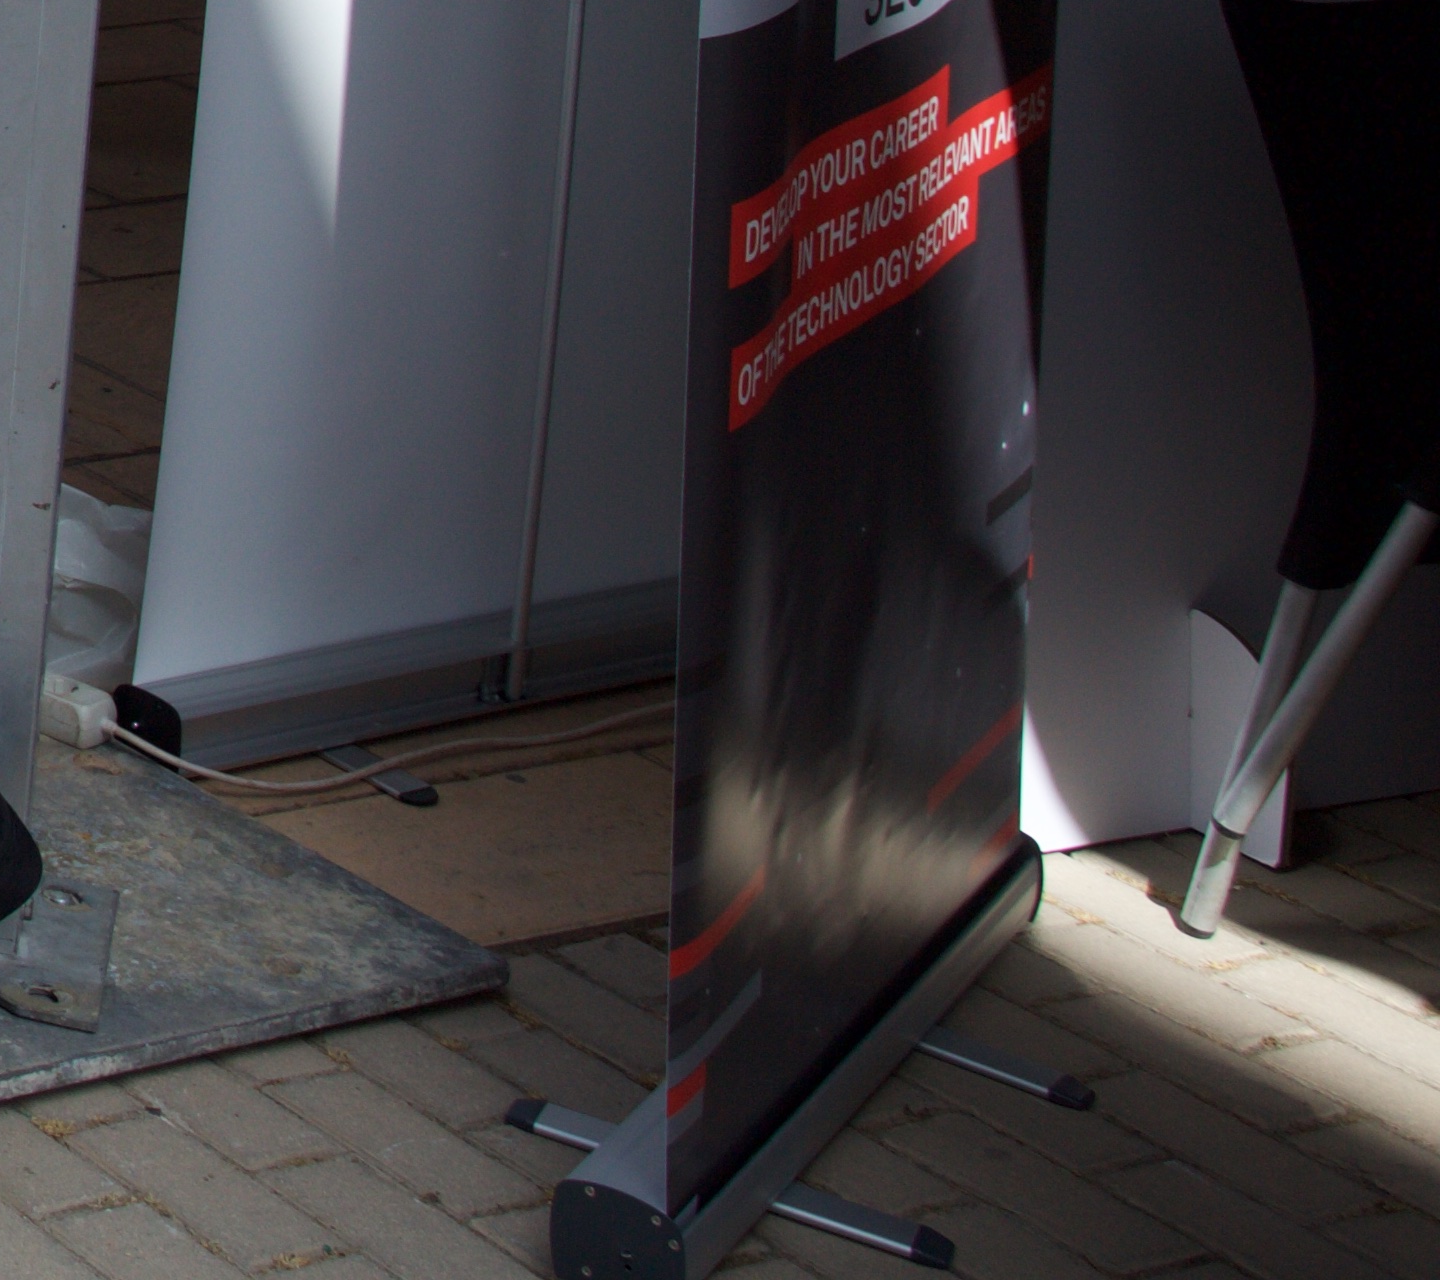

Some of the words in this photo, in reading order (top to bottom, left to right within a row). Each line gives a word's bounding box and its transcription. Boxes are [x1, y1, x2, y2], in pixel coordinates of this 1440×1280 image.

[746, 170, 809, 263] DEVELOP
[811, 135, 880, 200] YOUR
[870, 95, 939, 169] CAREER
[797, 232, 814, 279] IN
[816, 207, 860, 265] THE
[861, 177, 918, 239] MOST
[919, 116, 996, 208] RELEVANT
[995, 85, 1047, 151] AREAS
[737, 352, 763, 408] OF
[764, 325, 789, 383] THE
[787, 240, 915, 353] TECHNOLOGY
[914, 195, 970, 271] SECTOR
